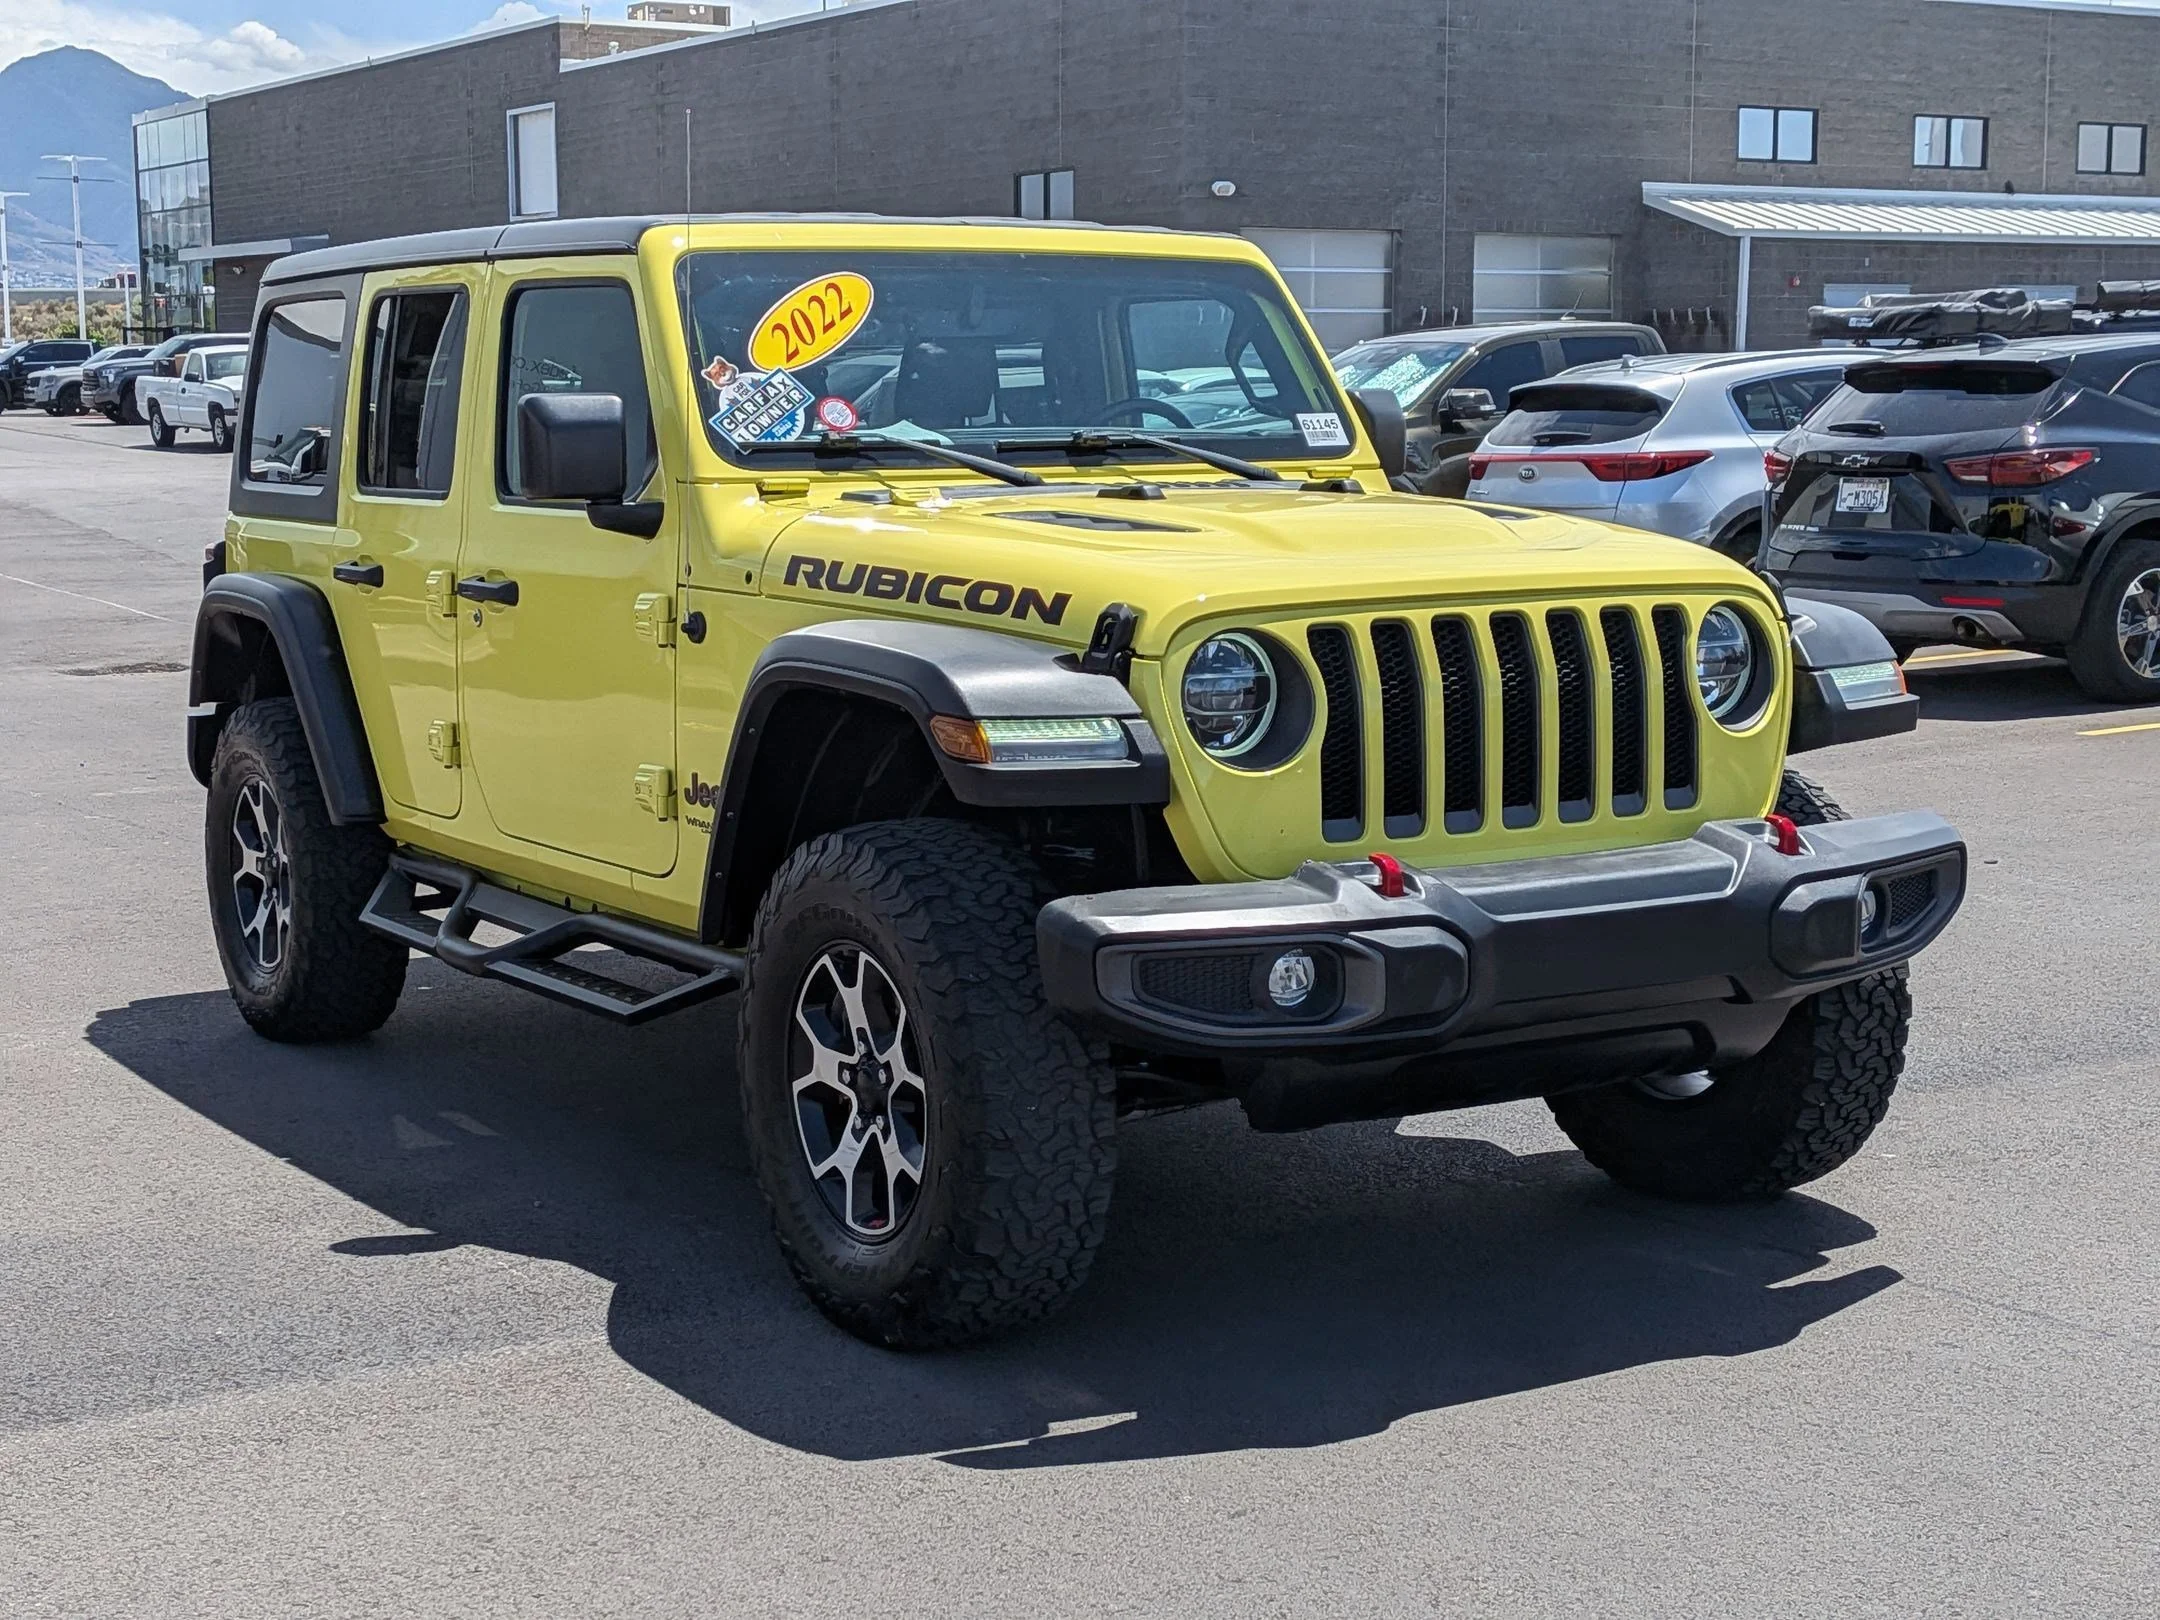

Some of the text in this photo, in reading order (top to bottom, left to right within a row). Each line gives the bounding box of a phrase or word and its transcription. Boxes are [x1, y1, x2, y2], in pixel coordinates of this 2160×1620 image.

[771, 283, 853, 364] 2022
[722, 378, 790, 430] CARFAX
[737, 431, 750, 442] 1
[749, 390, 803, 436] OWNER
[1302, 418, 1338, 430] 61145
[783, 555, 1073, 626] RUBICON
